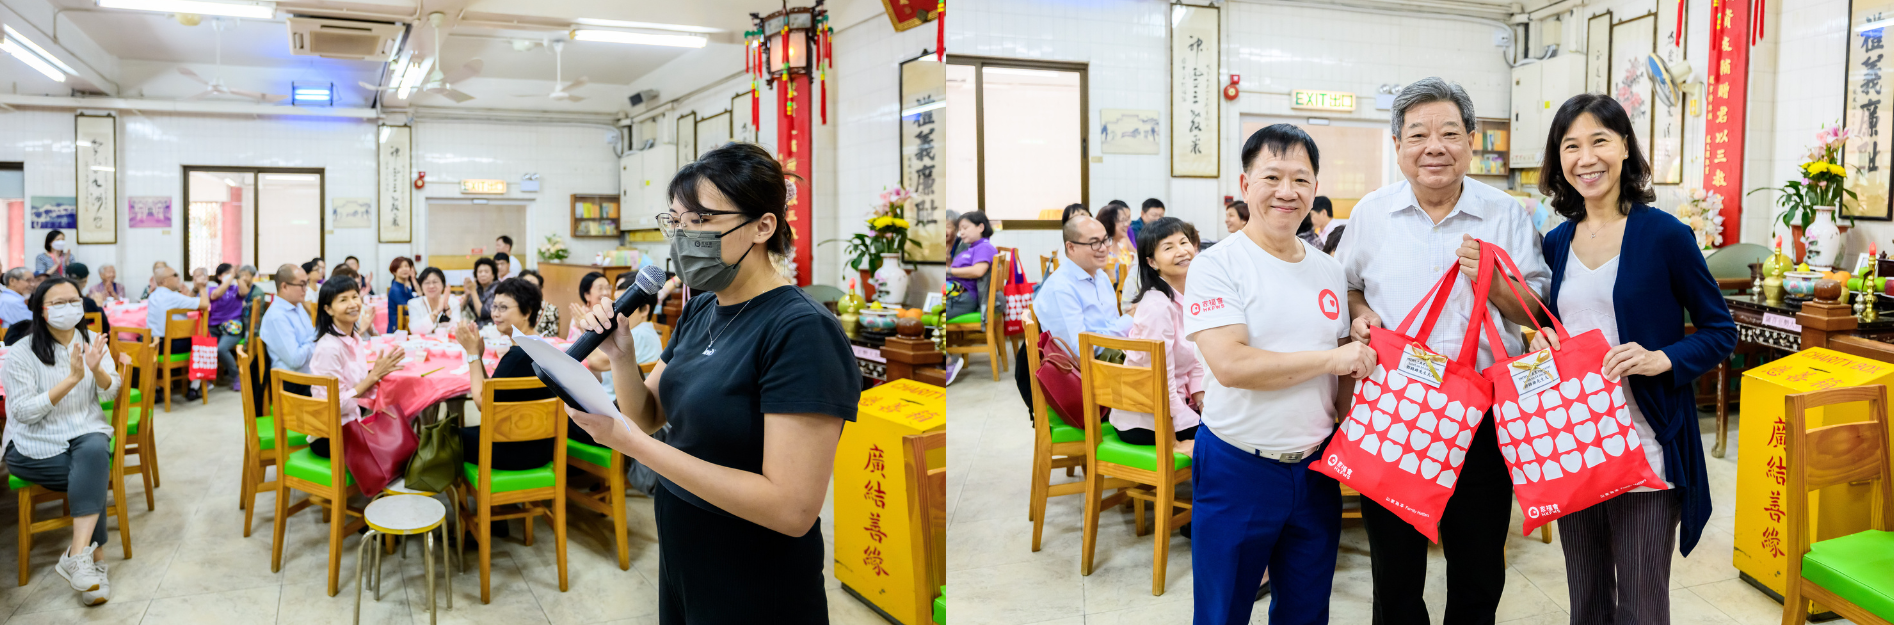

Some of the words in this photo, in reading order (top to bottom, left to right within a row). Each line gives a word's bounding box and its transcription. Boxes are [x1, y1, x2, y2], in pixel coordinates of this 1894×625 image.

[1296, 92, 1327, 106] EXIT
[1330, 94, 1352, 108] 出口
[463, 181, 486, 191] EXIT
[1802, 351, 1855, 367] CHARITY
[1853, 361, 1886, 374] BOX
[863, 444, 890, 576] 廣結善緣
